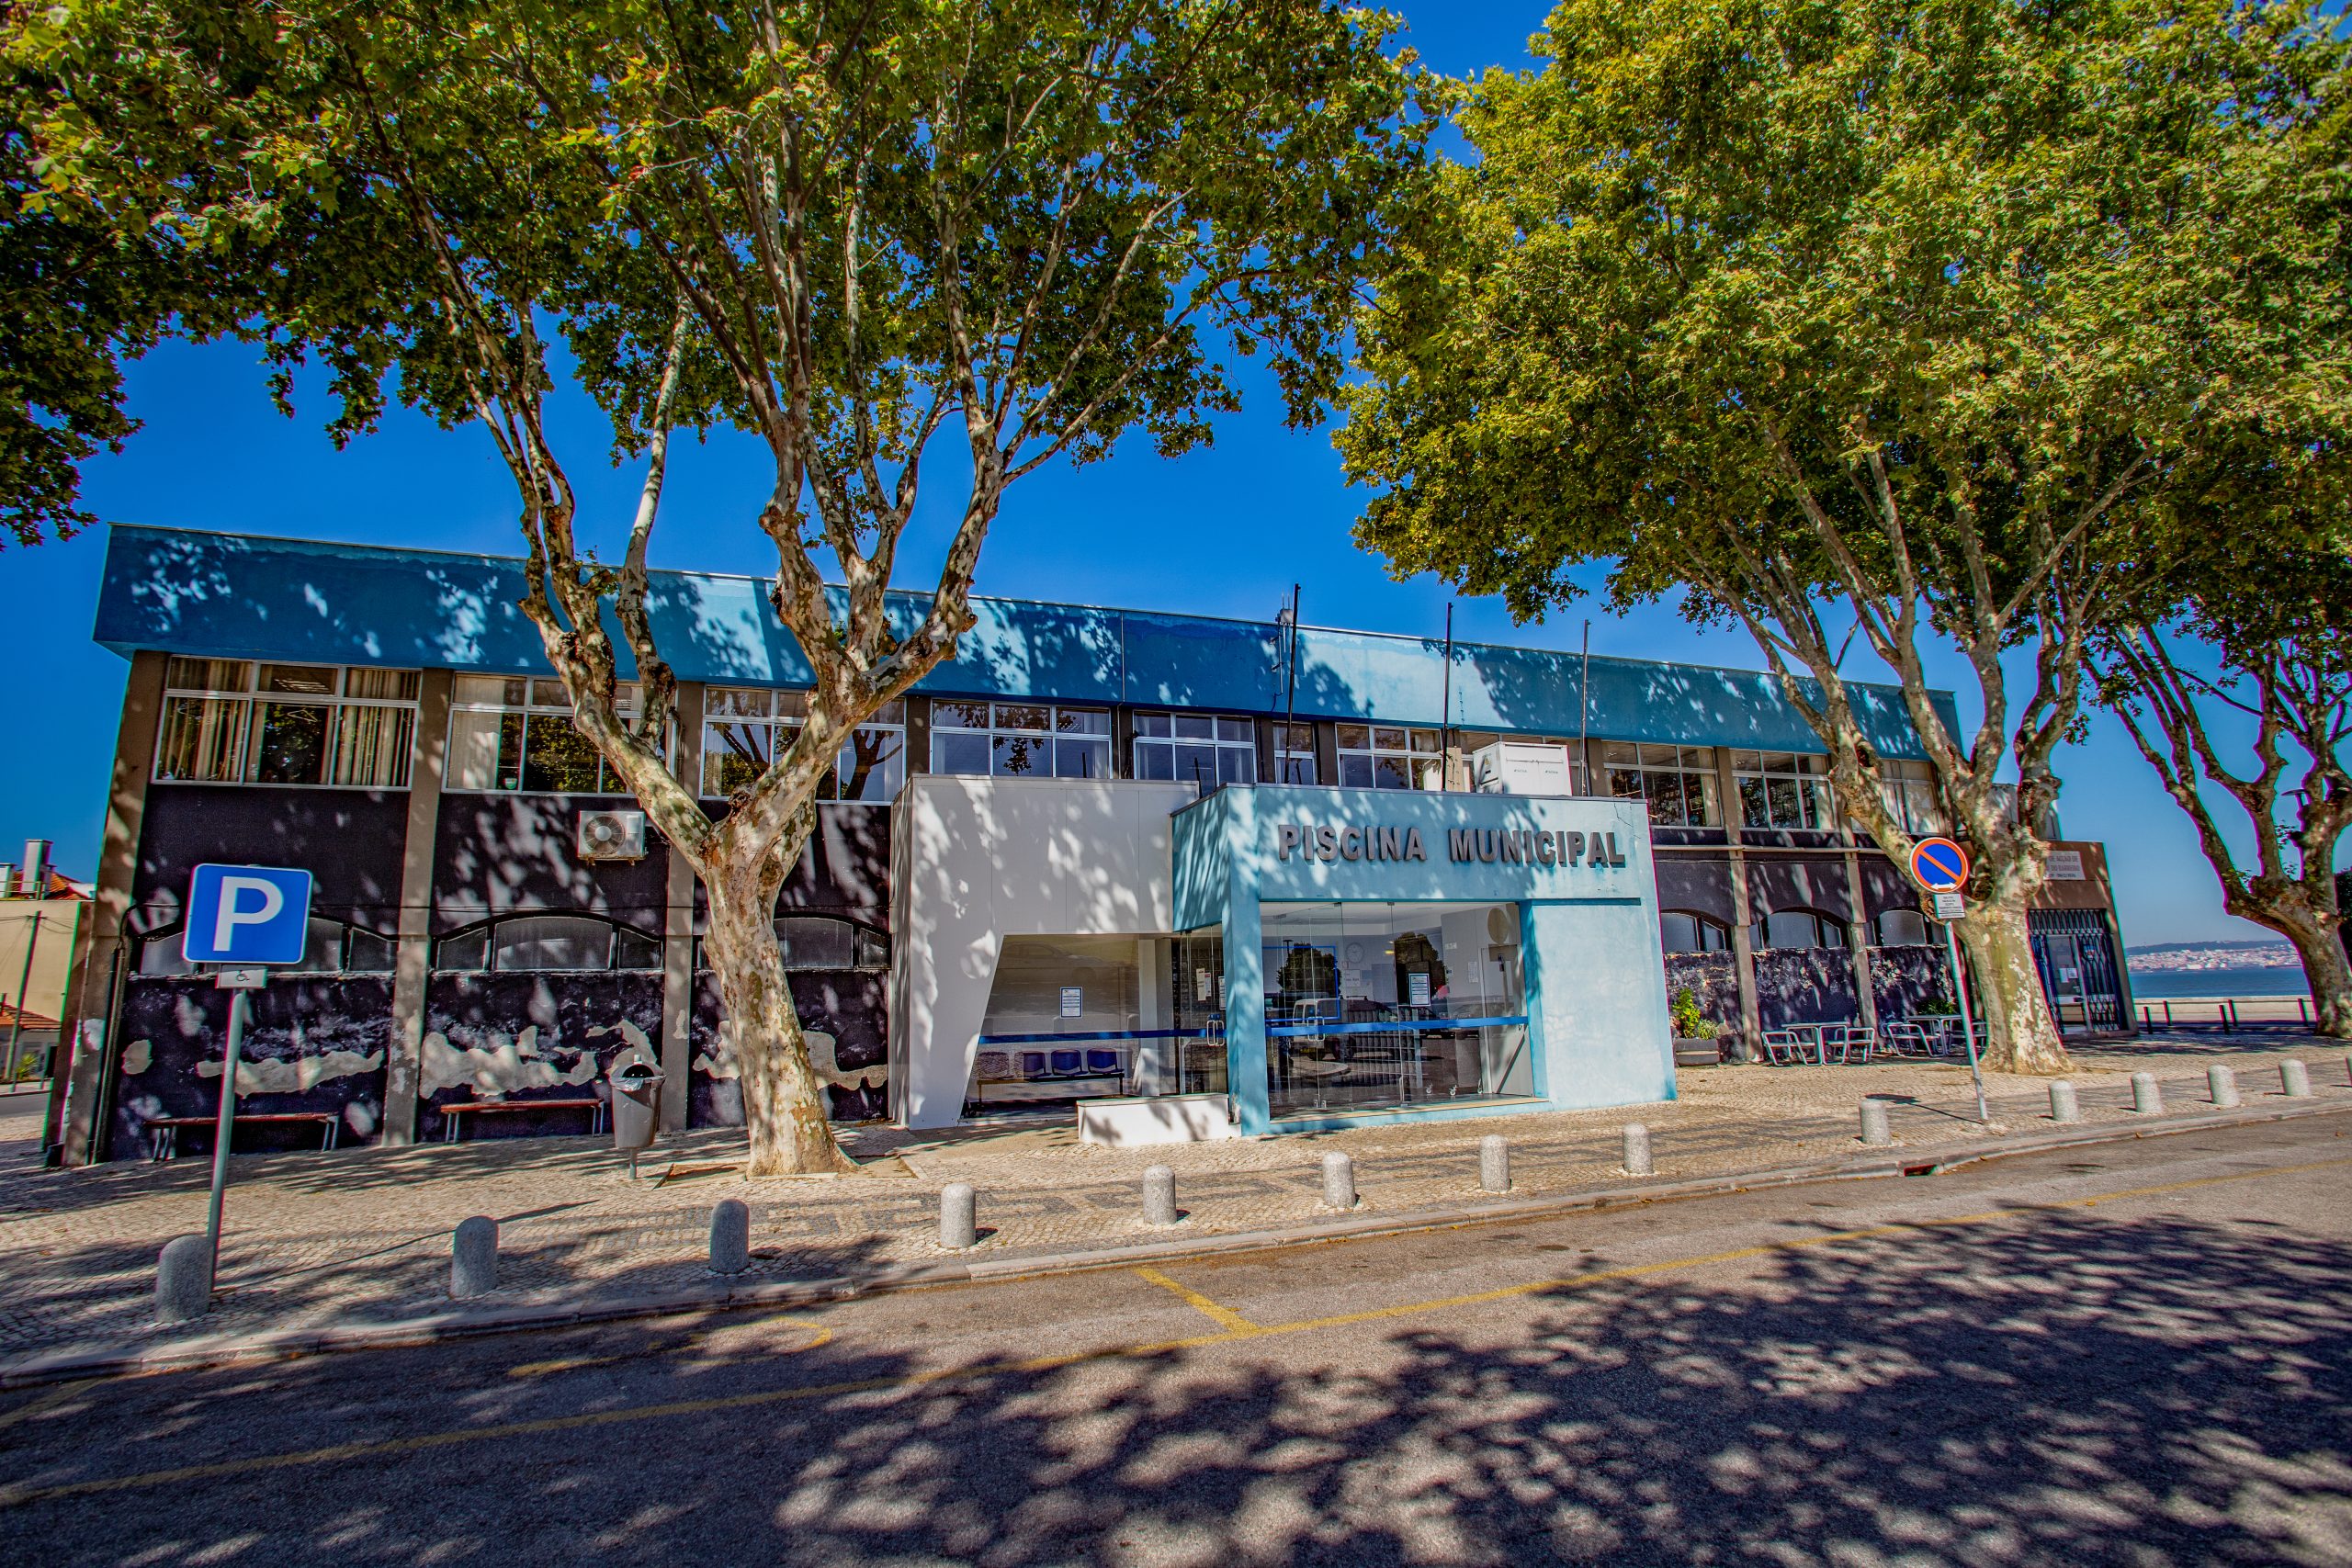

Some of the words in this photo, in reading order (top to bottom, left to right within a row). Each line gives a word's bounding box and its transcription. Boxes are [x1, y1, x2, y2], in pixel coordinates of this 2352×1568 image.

[1278, 824, 1427, 864] PISCINA
[1448, 828, 1625, 868] MUNICIPAL
[213, 875, 284, 952] P
